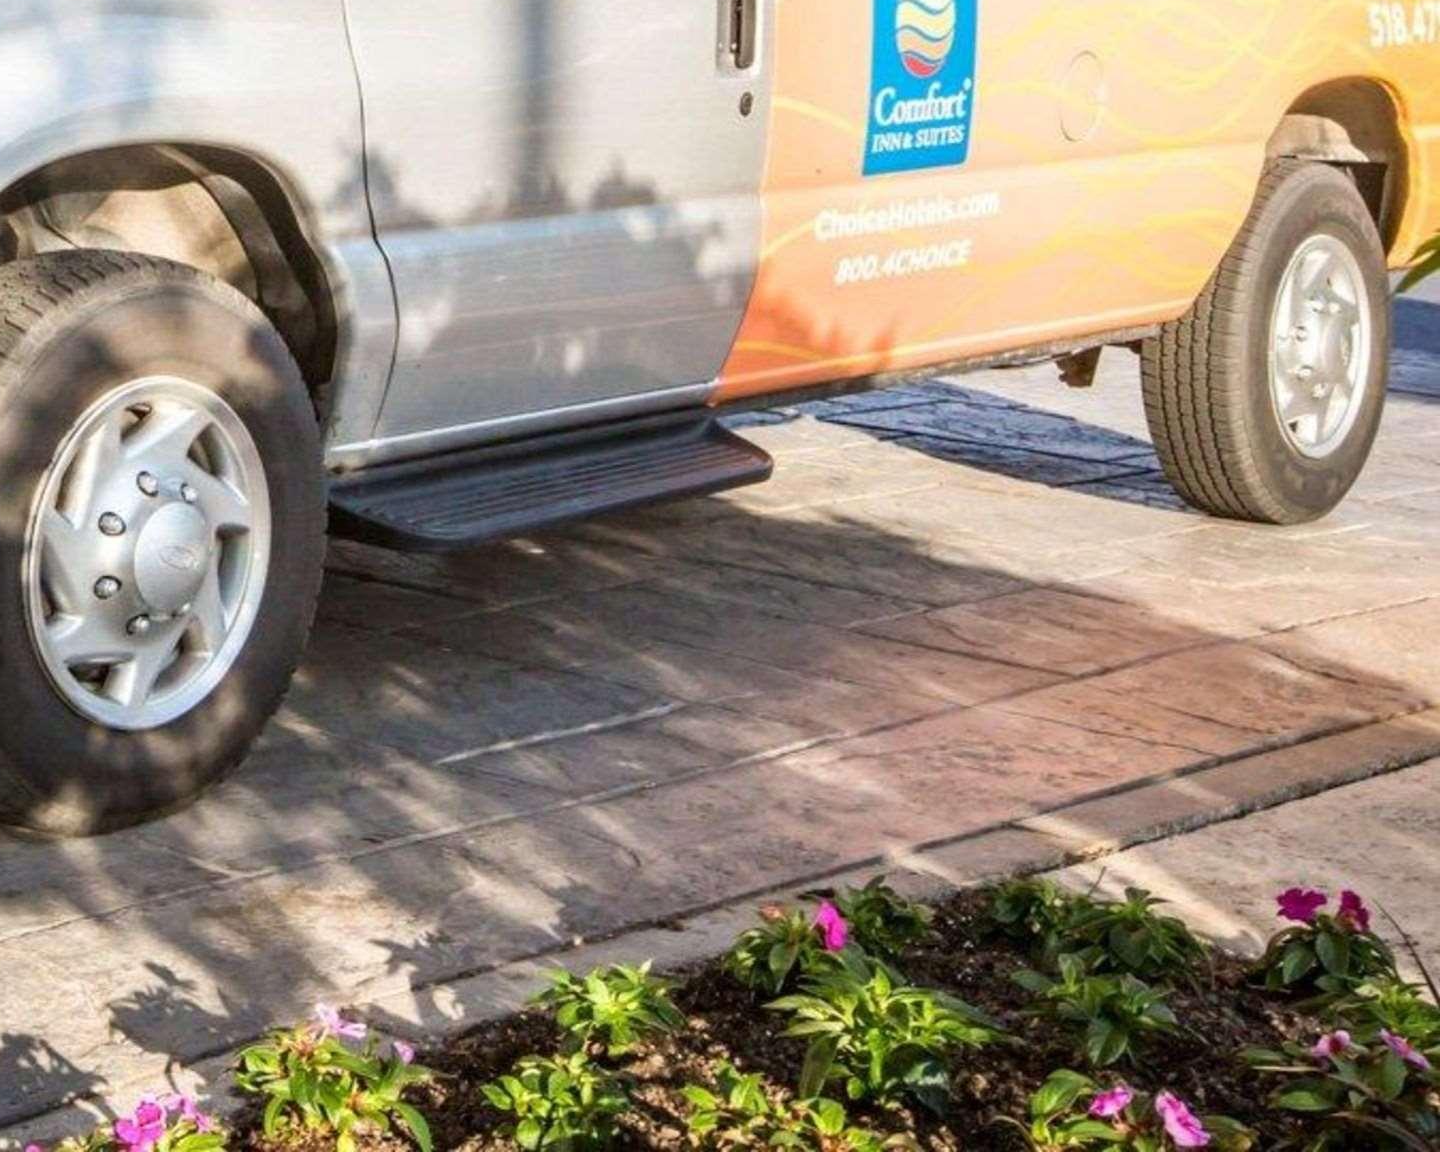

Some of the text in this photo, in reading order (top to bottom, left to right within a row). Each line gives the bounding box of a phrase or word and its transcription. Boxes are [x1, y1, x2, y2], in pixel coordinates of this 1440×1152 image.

[875, 78, 966, 129] Comfort
[871, 129, 902, 154] INN
[913, 124, 965, 151] SUITES
[816, 193, 1000, 238] ChoiceHotels.com
[836, 241, 971, 284] 800.4CHOICE
